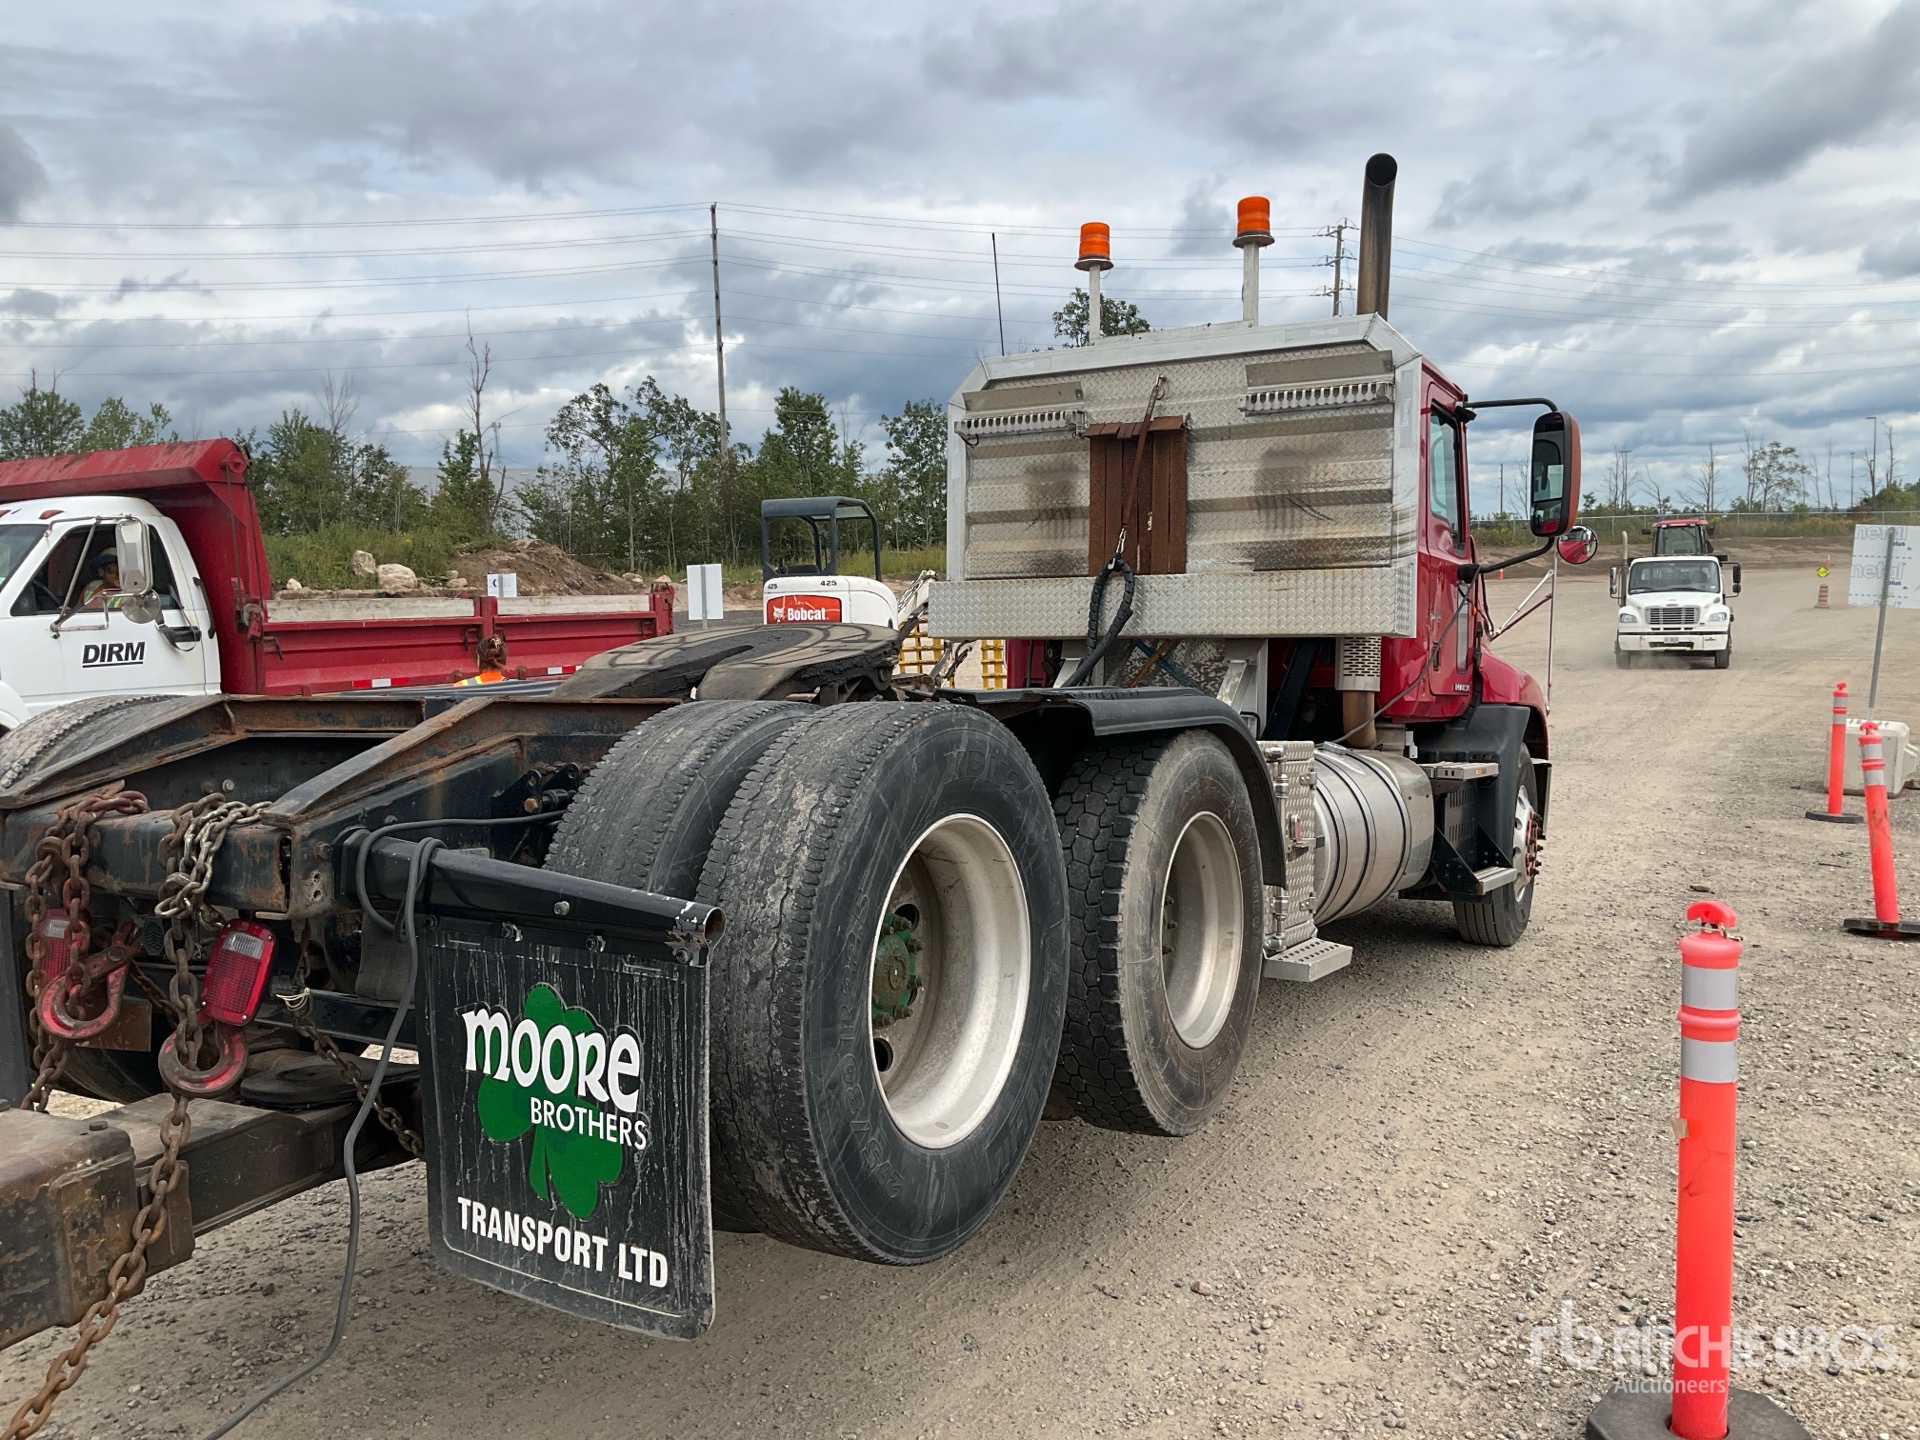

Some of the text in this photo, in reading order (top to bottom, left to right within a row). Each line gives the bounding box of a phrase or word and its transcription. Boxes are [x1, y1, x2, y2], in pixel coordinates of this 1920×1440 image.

[787, 607, 826, 621] Bobcat
[82, 641, 146, 664] DIRM
[529, 1096, 647, 1151] BROTHERS
[457, 1196, 669, 1289] TRANSPORT LTD
